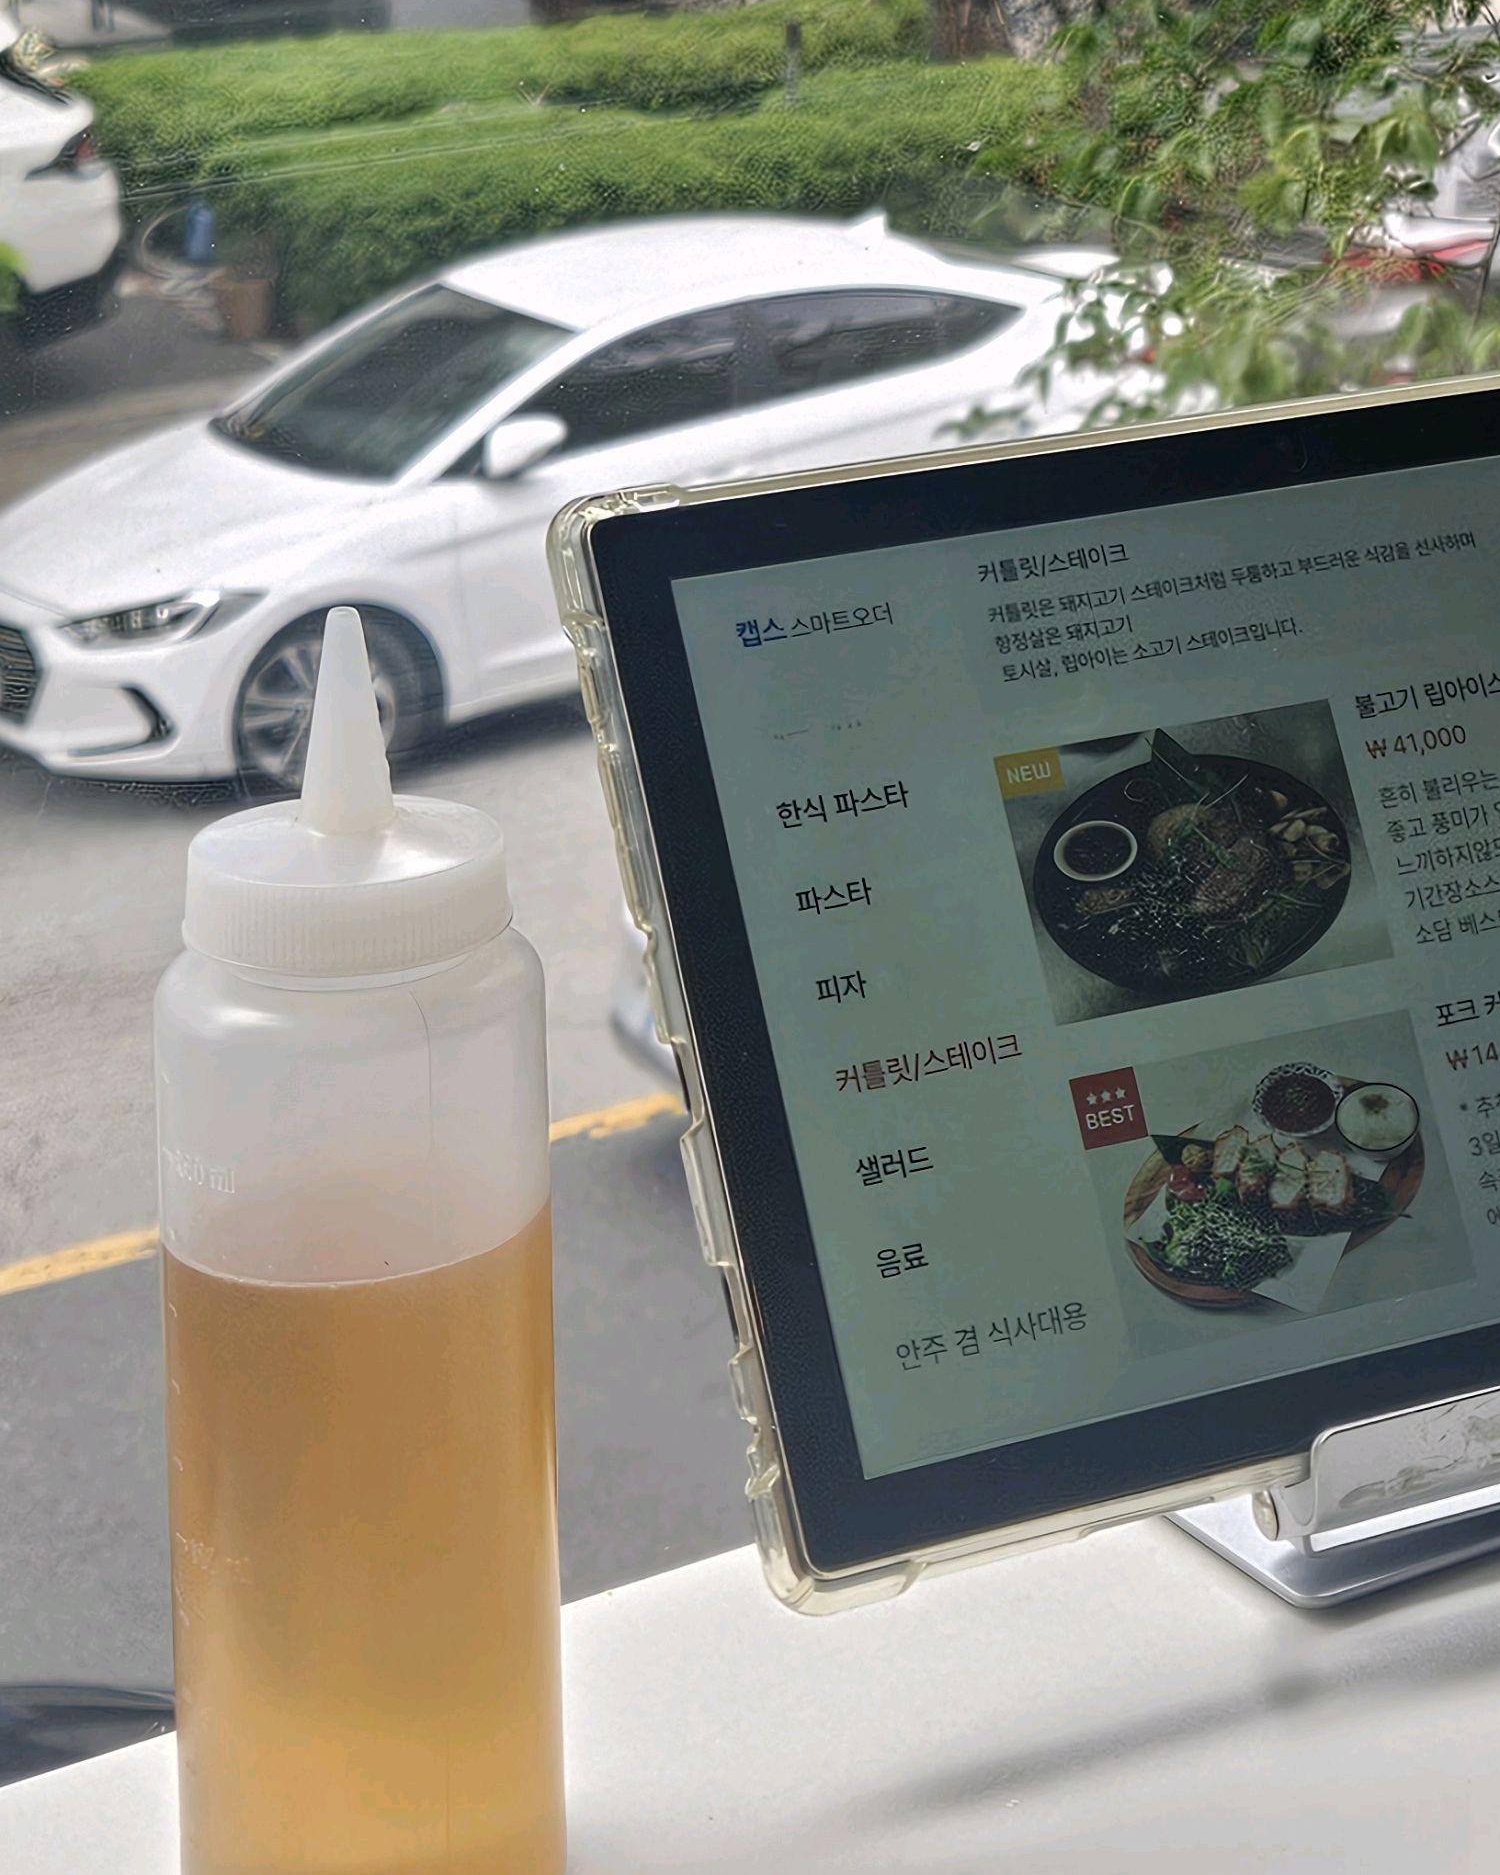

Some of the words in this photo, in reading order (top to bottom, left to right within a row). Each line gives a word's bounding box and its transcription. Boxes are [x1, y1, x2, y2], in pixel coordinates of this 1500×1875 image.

[978, 543, 1129, 583] 커틀릿/스테이크
[988, 597, 1055, 624] 커틀릿은
[1058, 586, 1127, 614] 돼지고기
[1129, 570, 1227, 602] 스테이크처럼
[1298, 549, 1360, 575] 부드러운
[735, 618, 788, 647] 캡스
[791, 602, 893, 637] 스마트오더
[994, 626, 1062, 655] 항정살은
[1065, 615, 1134, 641] 돼지고기
[1001, 659, 1059, 682] 토시살,
[1061, 647, 1129, 673] 립아이는
[1131, 636, 1182, 661] 소고기
[1185, 616, 1305, 653] 스테이크입니다.
[1354, 685, 1420, 719] 불고기
[1007, 762, 1051, 784] NEW
[776, 794, 828, 829] 한식
[833, 781, 909, 817] 파스타
[1432, 804, 1489, 836] 풍미가
[795, 877, 872, 915] 파스타
[815, 970, 867, 1004] 피자
[1435, 998, 1480, 1027] 포크
[834, 1033, 1023, 1093] 커틀릿/스테이크
[1086, 1104, 1135, 1130] BEST
[856, 1146, 935, 1187] 샐러드
[876, 1243, 929, 1279] 음료
[896, 1333, 948, 1371] 안주
[954, 1325, 981, 1357] 겸
[988, 1301, 1088, 1345] 식사대용
